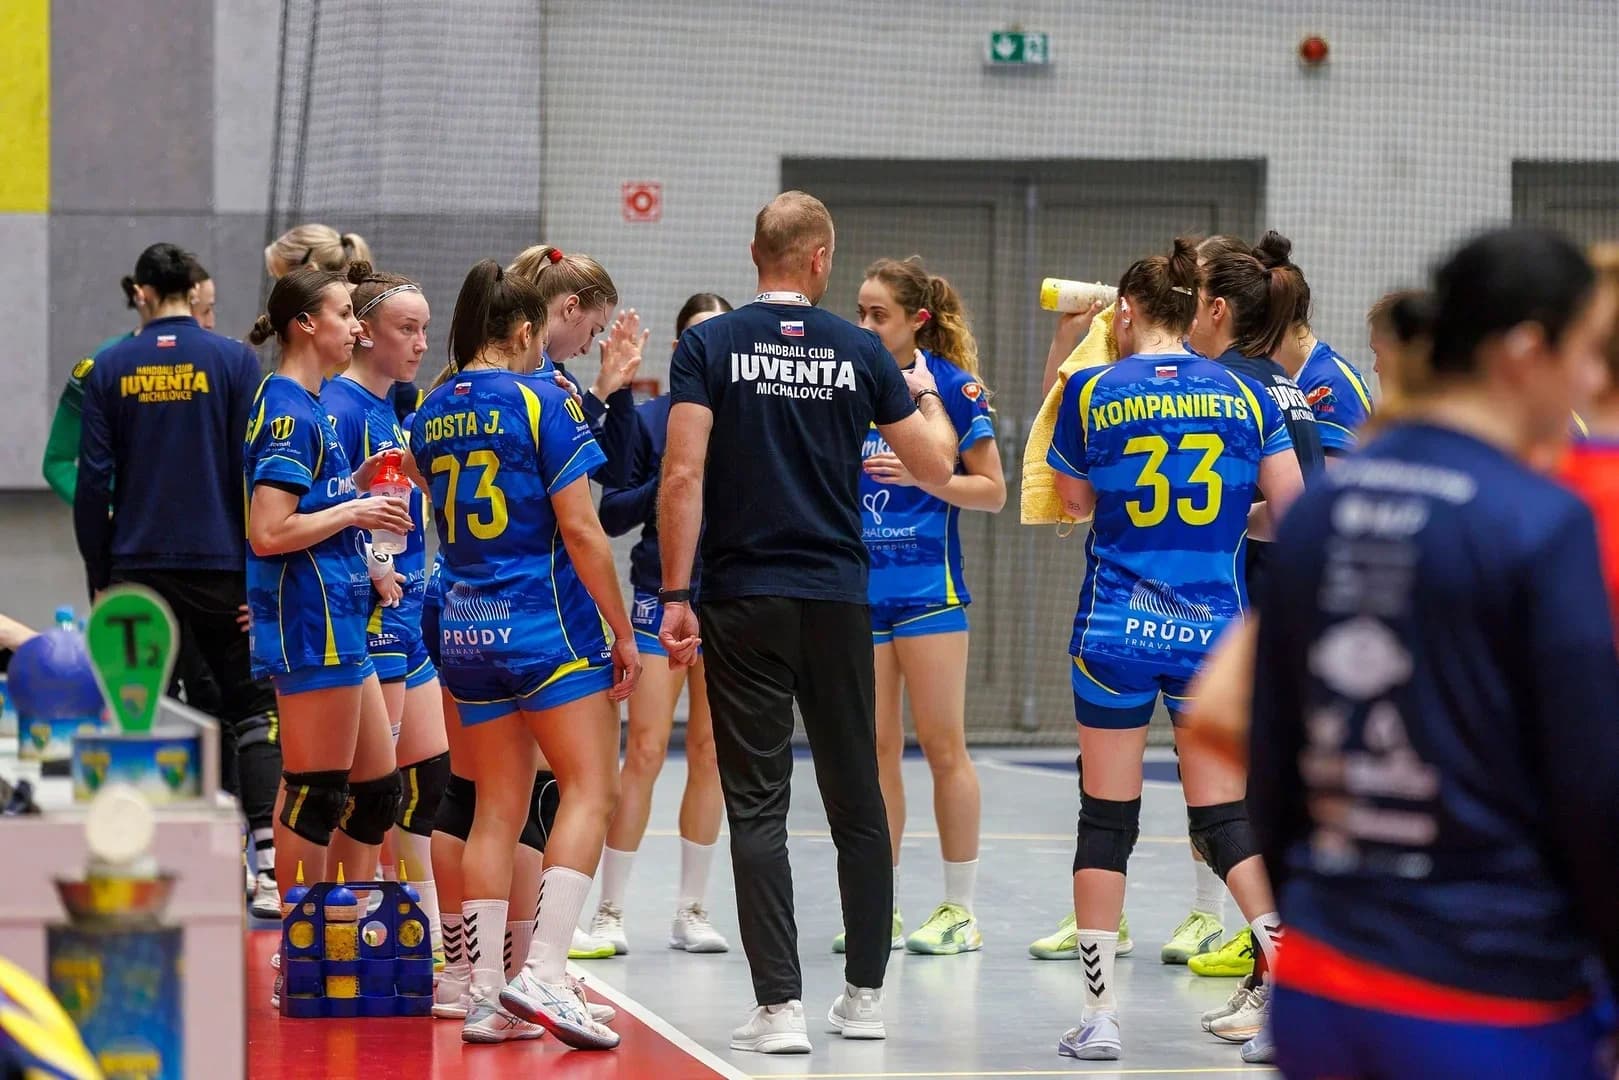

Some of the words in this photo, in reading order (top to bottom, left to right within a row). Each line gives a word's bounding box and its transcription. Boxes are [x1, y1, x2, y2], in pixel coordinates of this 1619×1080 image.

[754, 342, 806, 358] HANDBALL
[808, 347, 835, 360] CLUB
[136, 366, 174, 376] HANDBALL
[174, 363, 194, 374] CLUB
[731, 352, 857, 392] IUVENTA
[121, 371, 209, 398] IUVENTA
[138, 390, 192, 403] MICHALOVCE
[756, 382, 833, 400] MICHALOVCE
[1092, 394, 1248, 431] KOMPANIIETS
[425, 411, 478, 443] COSTA
[484, 410, 504, 434] J.
[1123, 433, 1224, 528] 33
[431, 449, 508, 544] 73
[443, 624, 512, 646] PRÚDY
[1125, 618, 1213, 645] PRÚDY
[1125, 638, 1171, 651] TRNAVA
